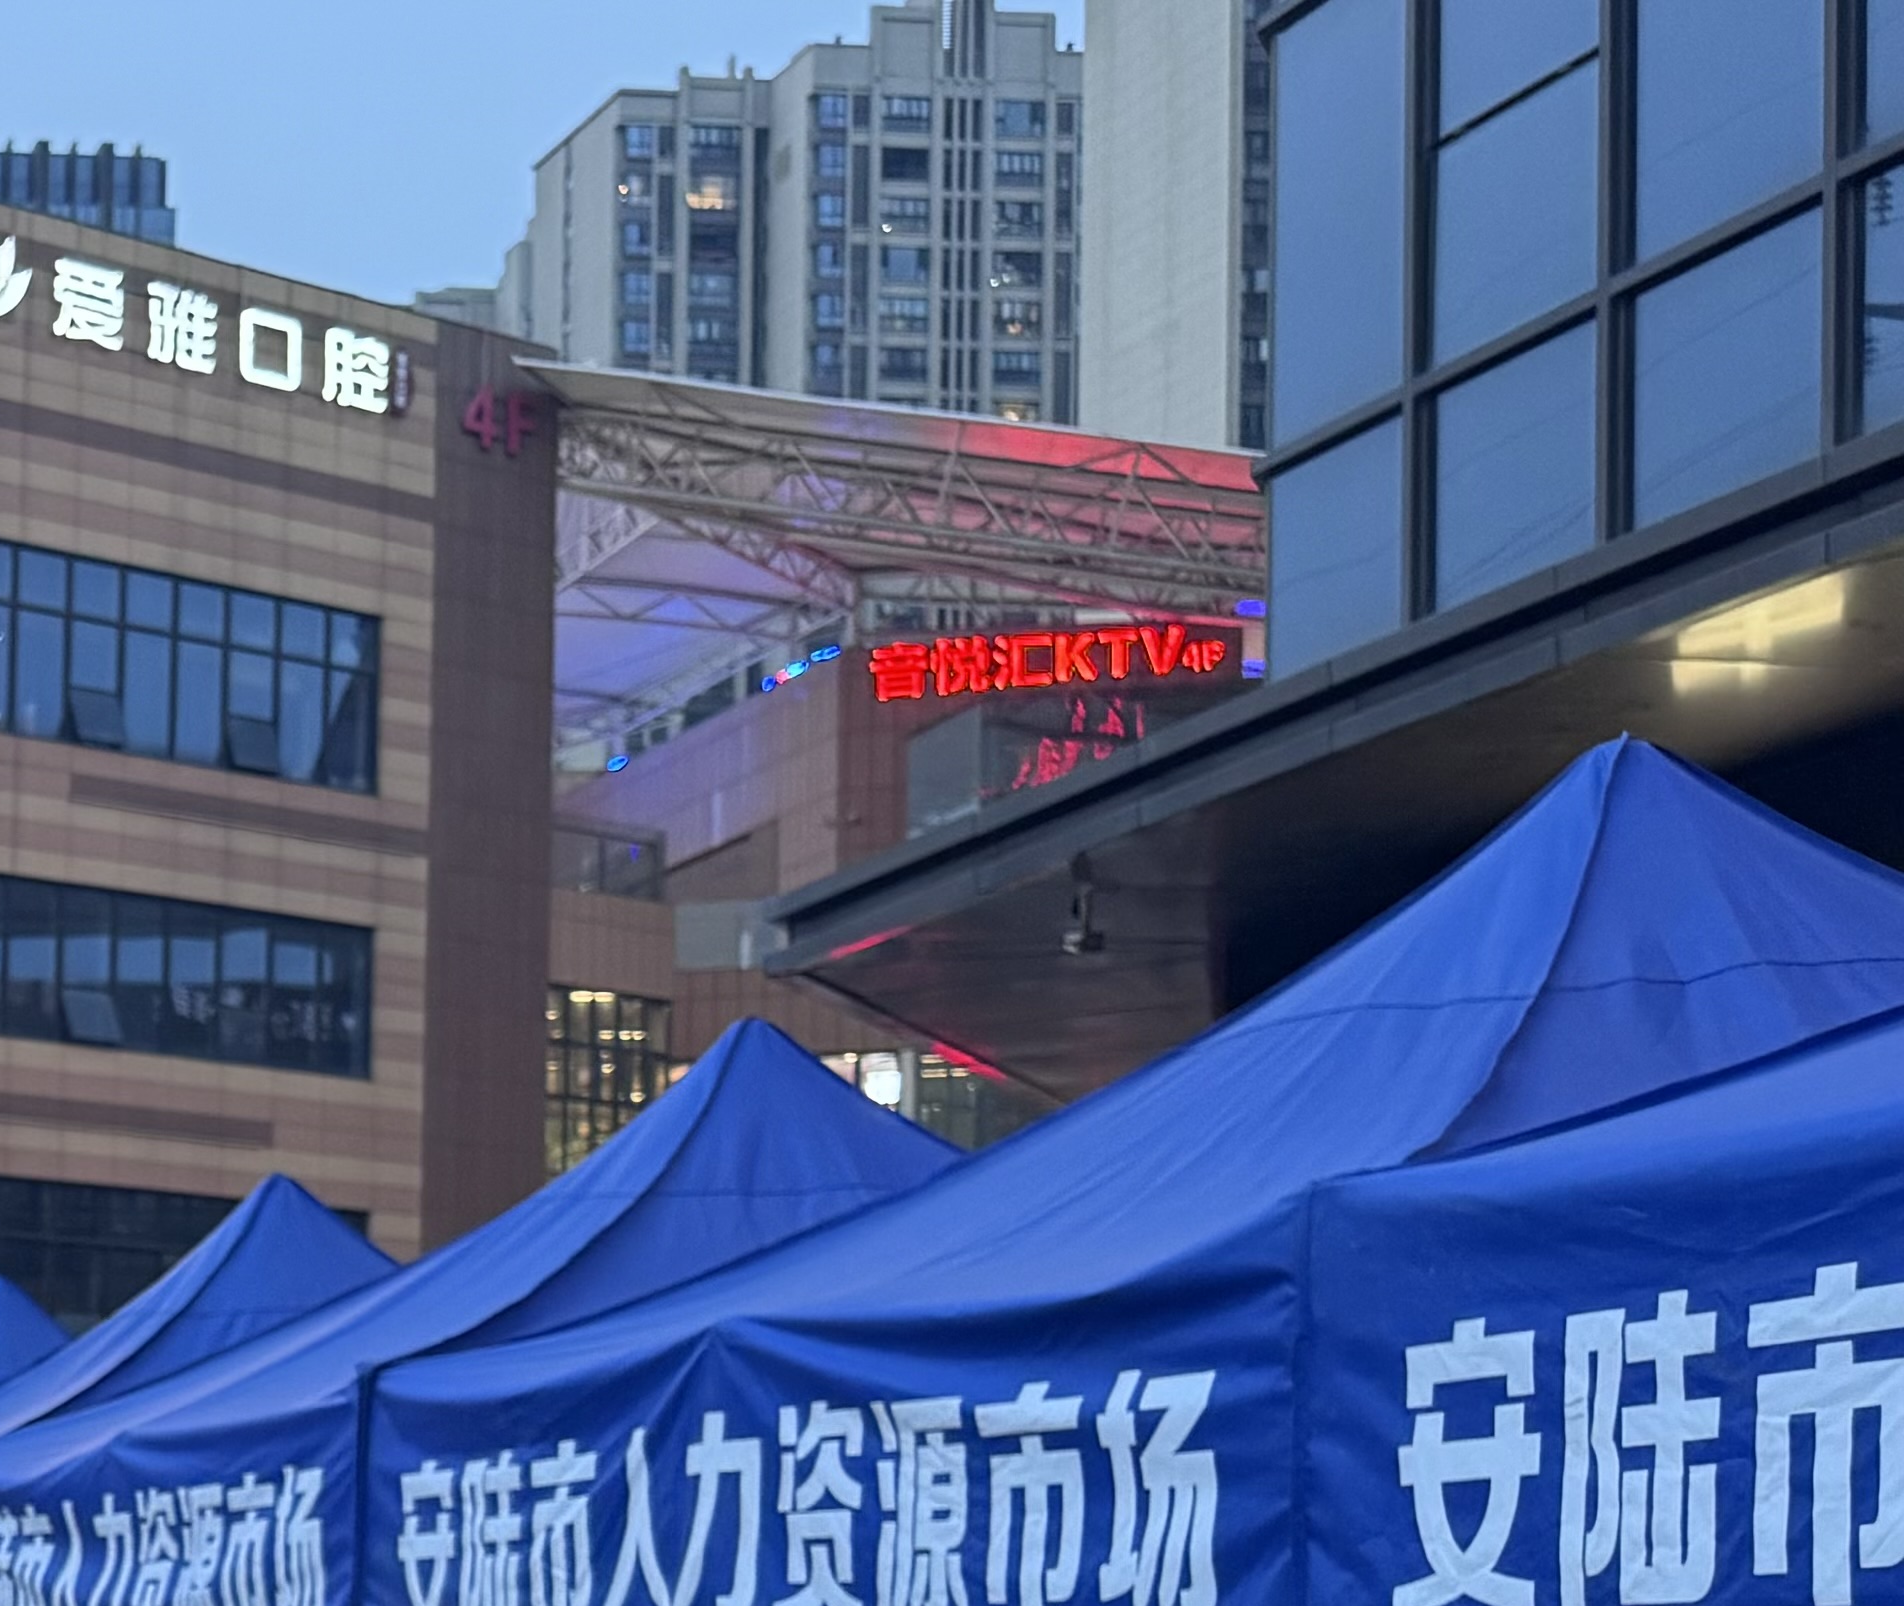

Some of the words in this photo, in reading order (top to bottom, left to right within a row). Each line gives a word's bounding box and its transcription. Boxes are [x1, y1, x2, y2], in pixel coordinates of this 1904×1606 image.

[51, 256, 392, 414] 爱雅口腔
[463, 383, 536, 454] 4F
